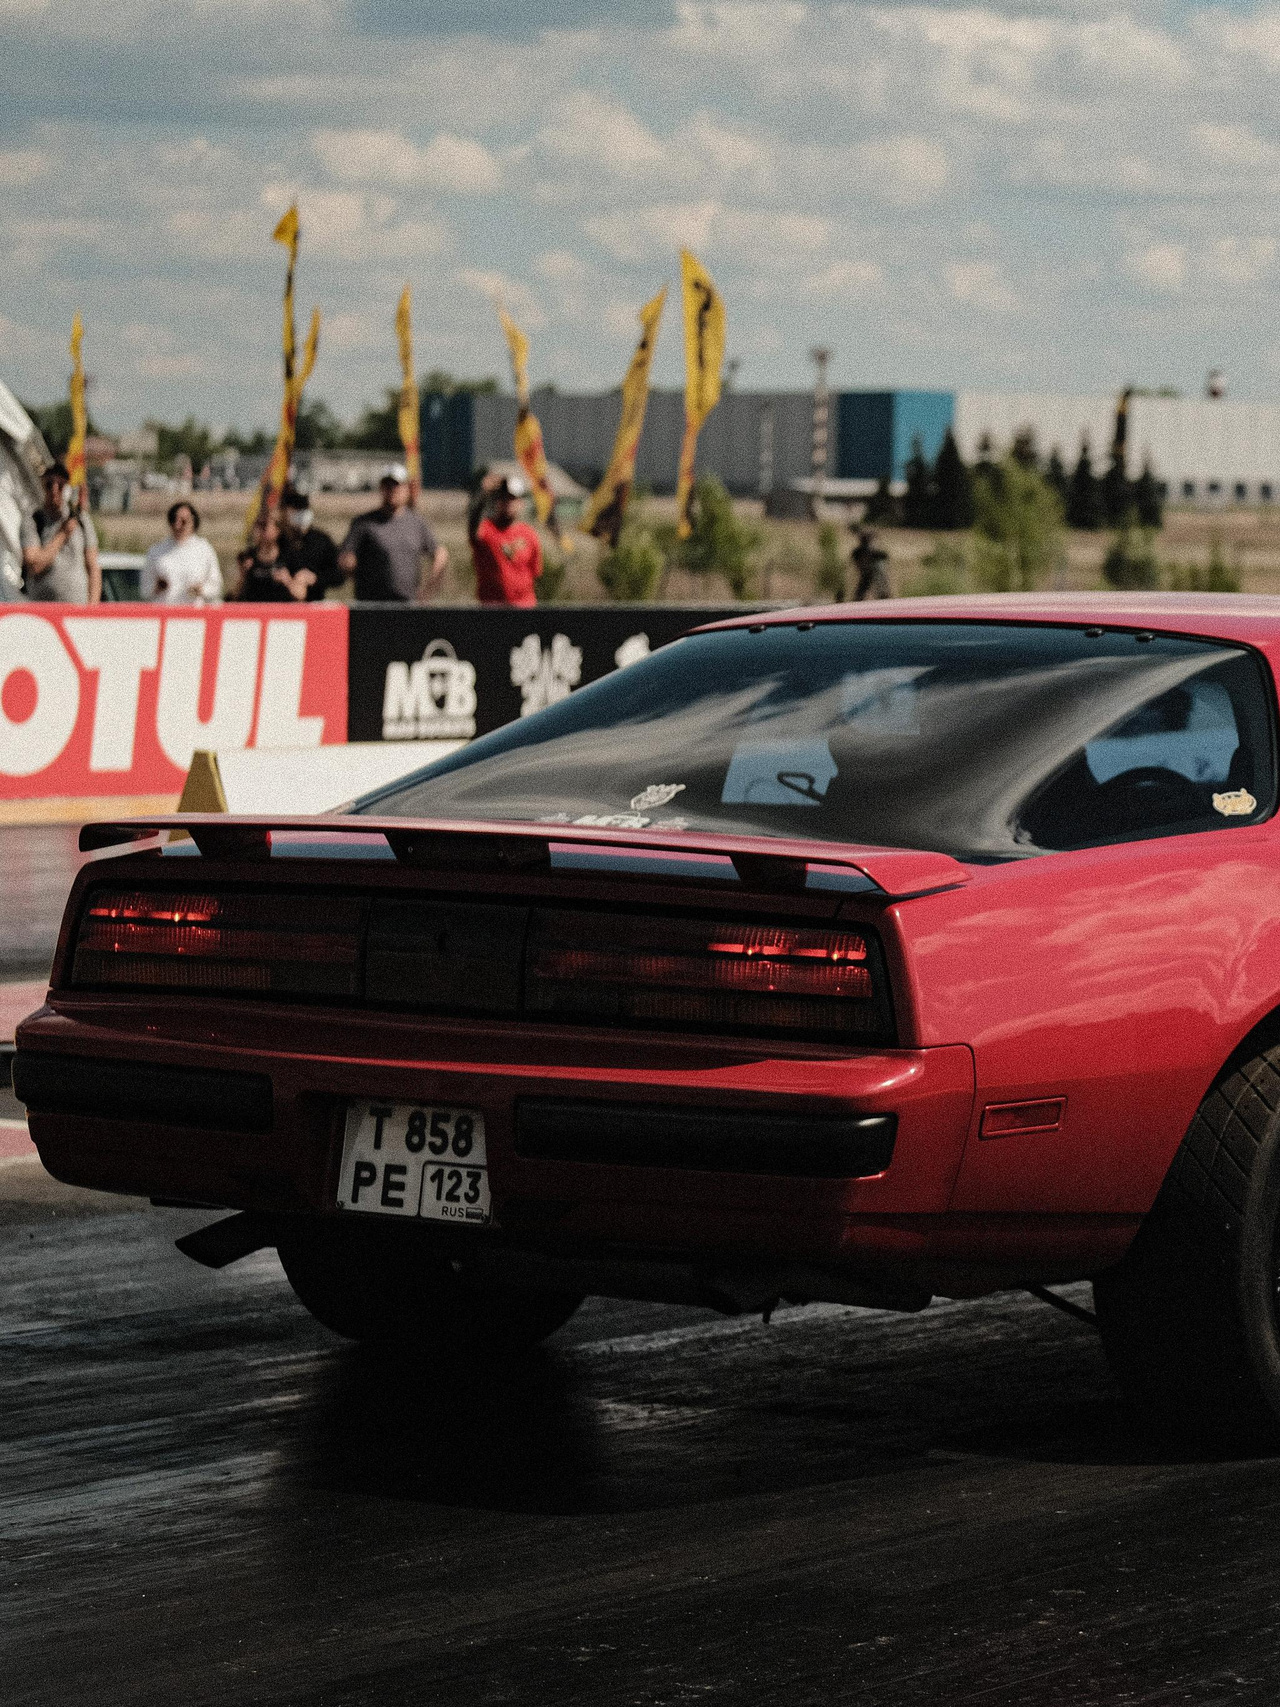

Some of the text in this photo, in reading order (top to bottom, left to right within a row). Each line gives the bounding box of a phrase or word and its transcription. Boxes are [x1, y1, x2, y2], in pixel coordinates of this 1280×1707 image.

[369, 1106, 474, 1158] T 858
[351, 1160, 482, 1208] PE 123
[441, 1206, 465, 1218] RUS
